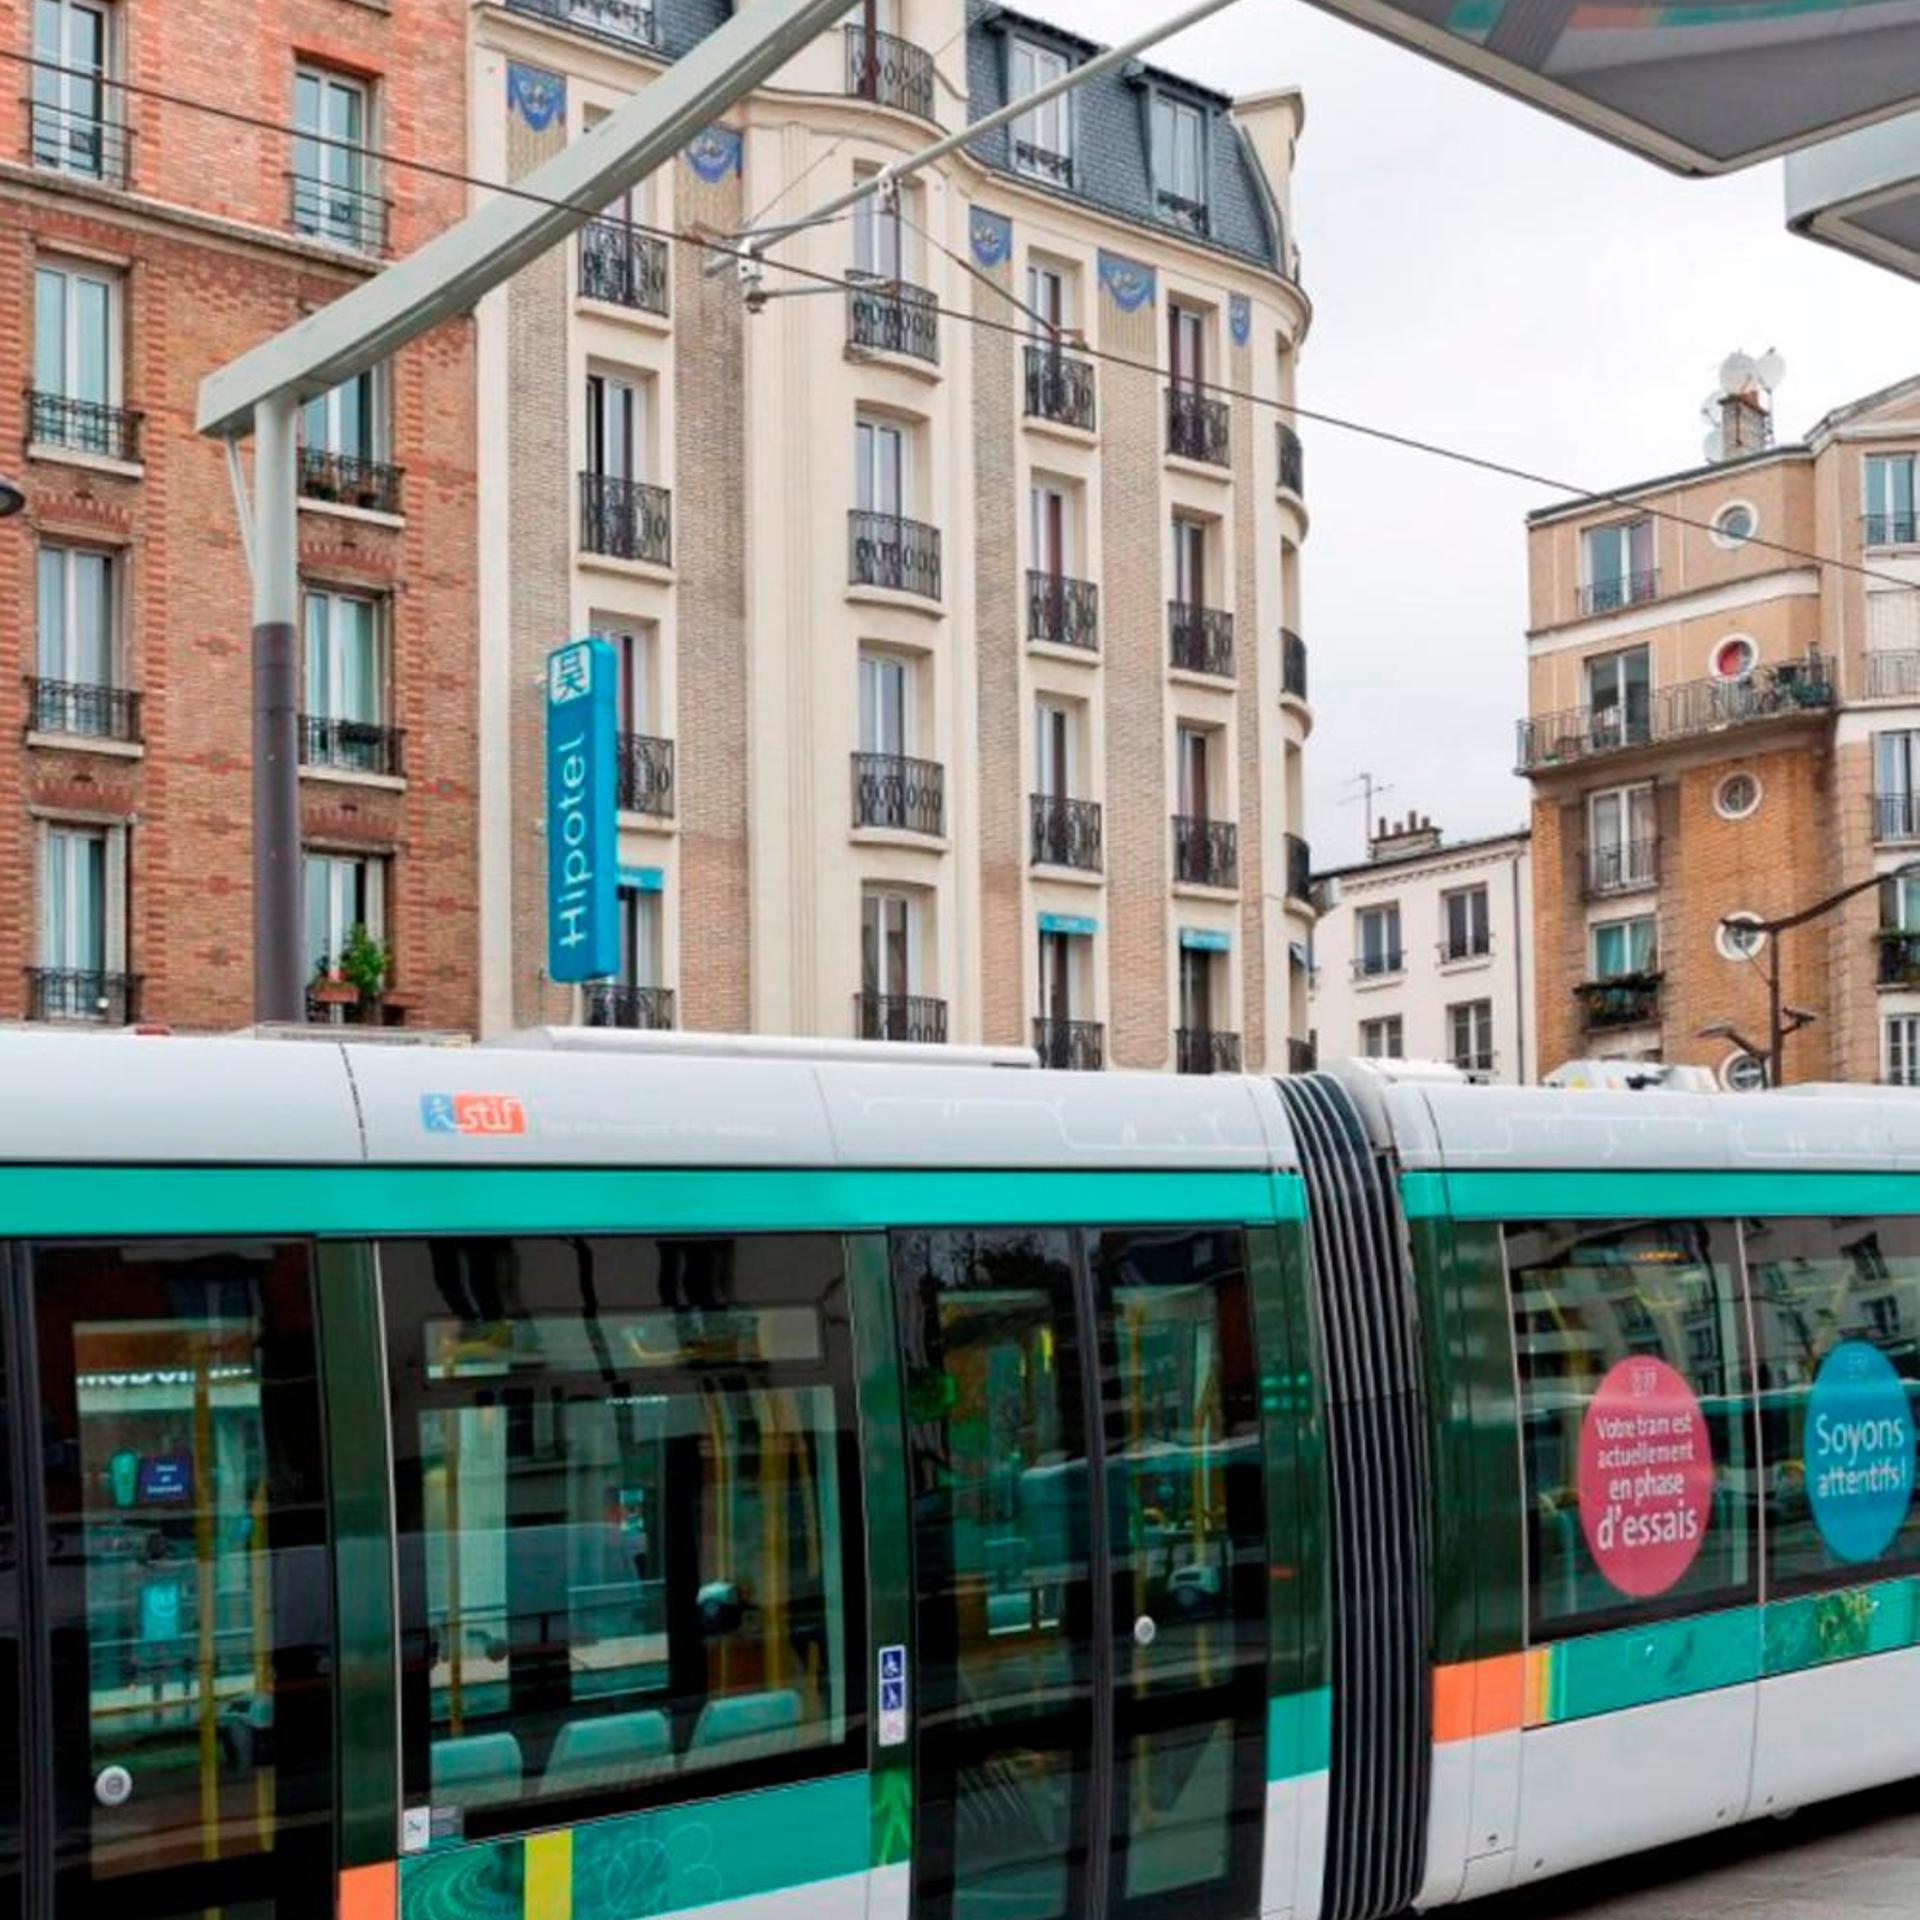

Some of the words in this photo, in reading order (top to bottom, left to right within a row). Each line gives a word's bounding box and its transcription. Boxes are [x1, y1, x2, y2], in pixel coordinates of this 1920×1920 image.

[557, 732, 594, 948] Hipotel
[459, 1096, 522, 1130] stif
[1596, 1417, 1636, 1440] Votre
[1671, 1411, 1692, 1434] est
[1816, 1413, 1904, 1467] Soyons
[1597, 1440, 1694, 1469] actuellement
[1608, 1477, 1632, 1501] en
[1634, 1467, 1684, 1507] phase
[1597, 1499, 1697, 1550] d'essais
